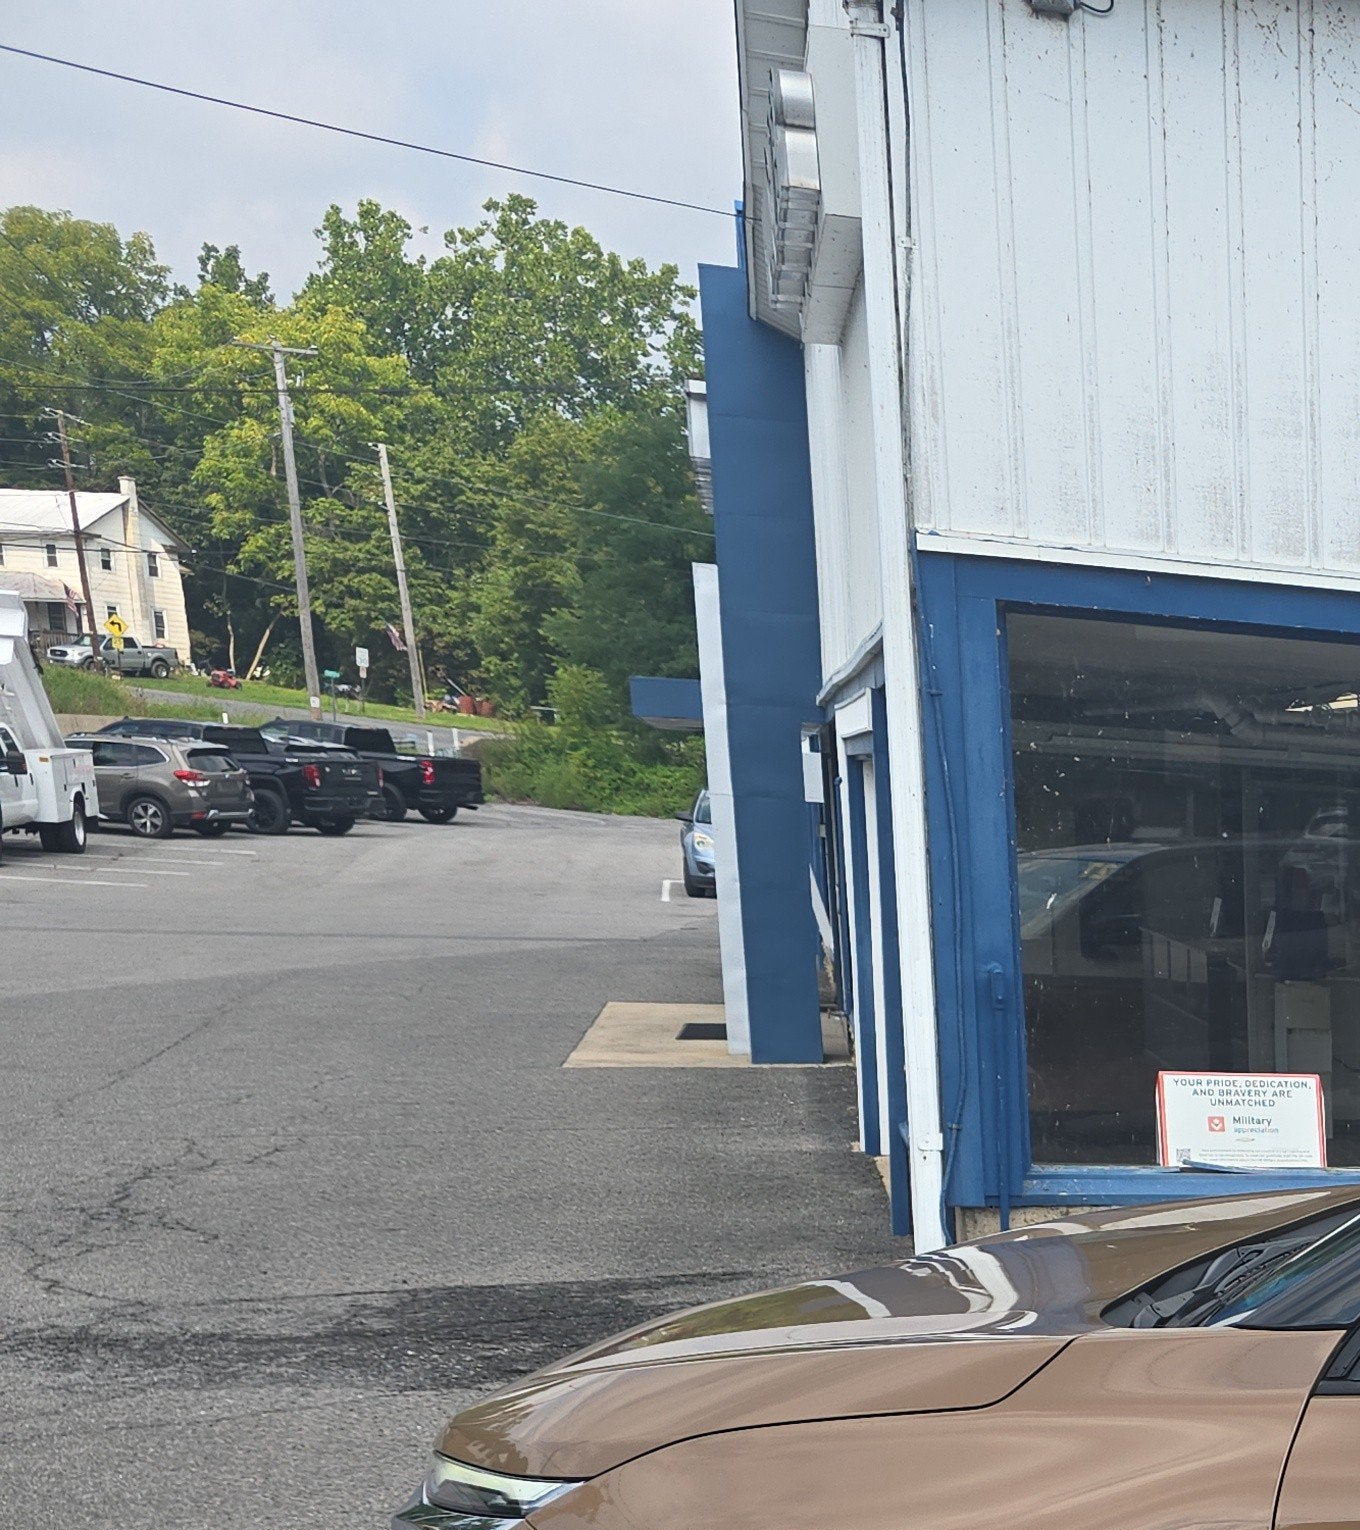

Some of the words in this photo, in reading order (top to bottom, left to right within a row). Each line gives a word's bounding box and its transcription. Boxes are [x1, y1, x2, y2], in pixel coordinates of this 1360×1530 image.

[1173, 1078, 1202, 1087] YOUR
[1206, 1079, 1242, 1088] PRIDE,
[1245, 1080, 1312, 1090] DEDICATION,
[1192, 1088, 1214, 1097] AND
[1218, 1089, 1269, 1098] BRAVERY
[1272, 1090, 1292, 1098] ARE
[1210, 1098, 1276, 1107] UNMATCHED
[1232, 1116, 1273, 1130] Military
